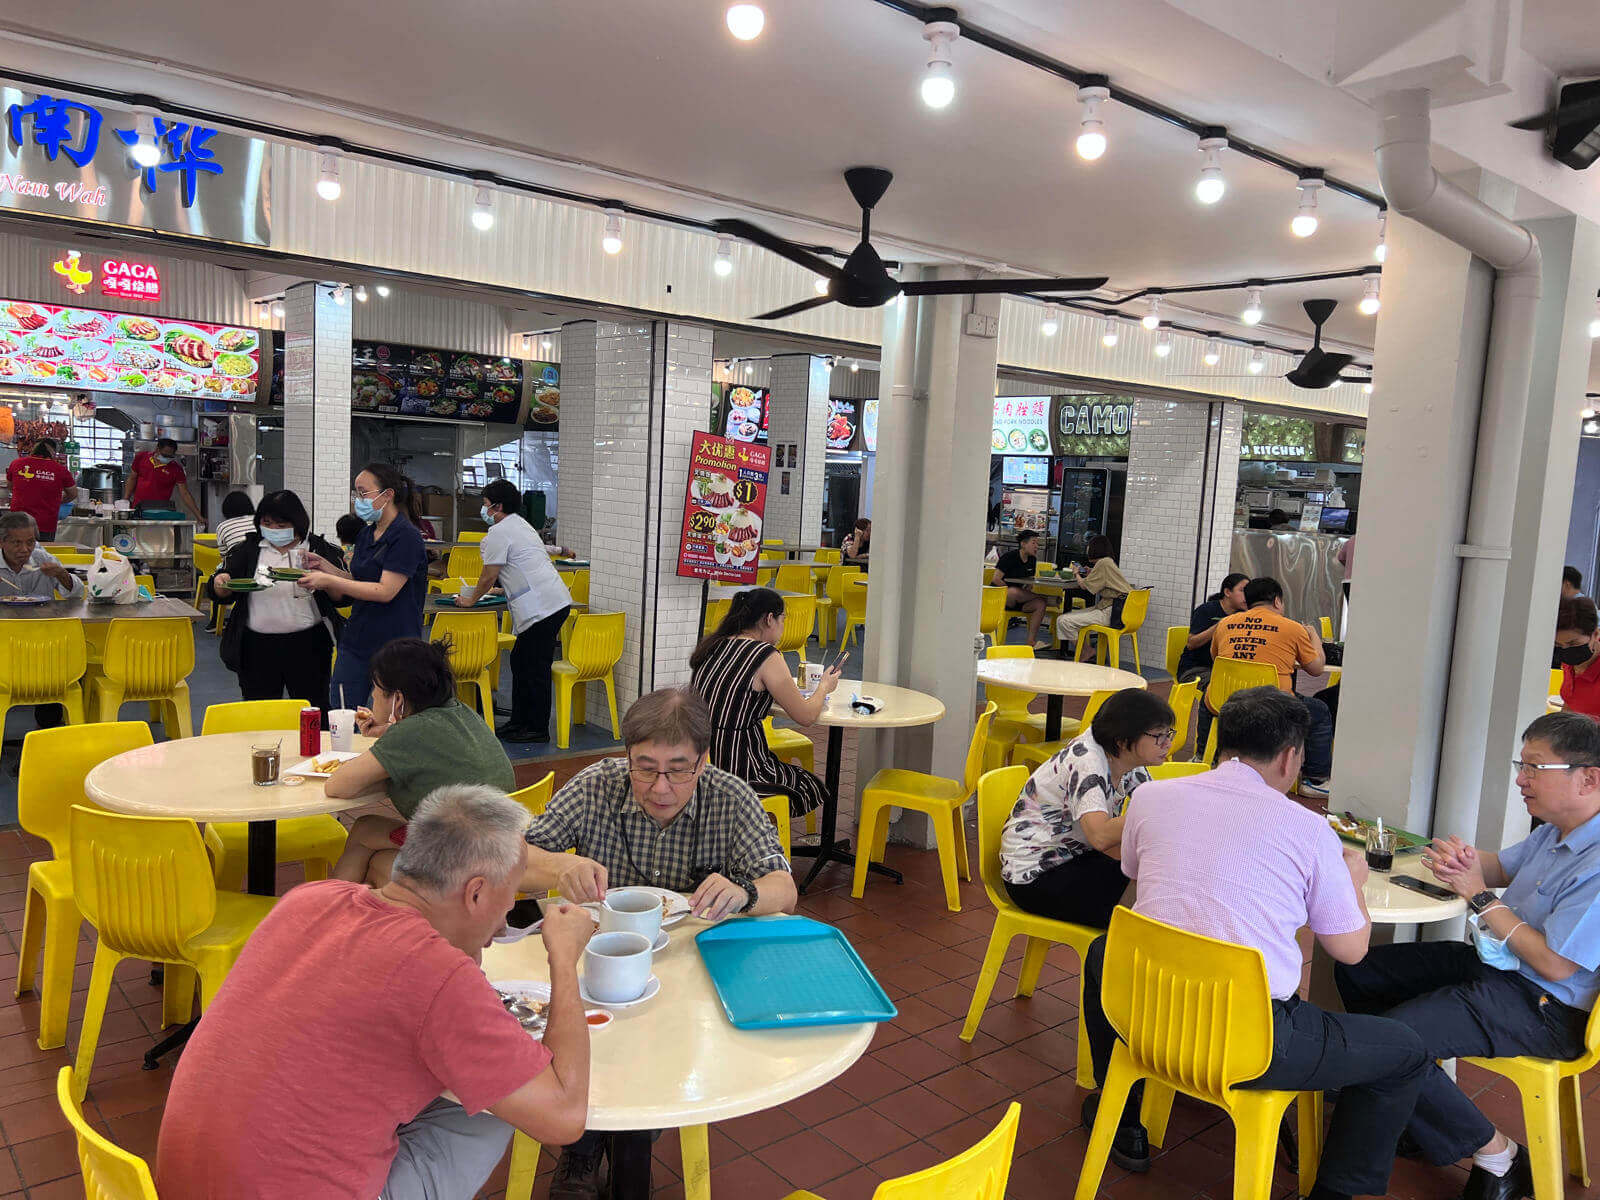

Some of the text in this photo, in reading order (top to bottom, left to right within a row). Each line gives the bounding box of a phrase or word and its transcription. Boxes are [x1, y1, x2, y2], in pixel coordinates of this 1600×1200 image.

[0, 173, 107, 207] Nam Wah
[698, 440, 735, 460] 大优惠
[1253, 446, 1305, 456] KITCHEN
[695, 455, 737, 471] Promotion
[1227, 624, 1279, 632] WONDER
[1229, 637, 1267, 645] NEVER
